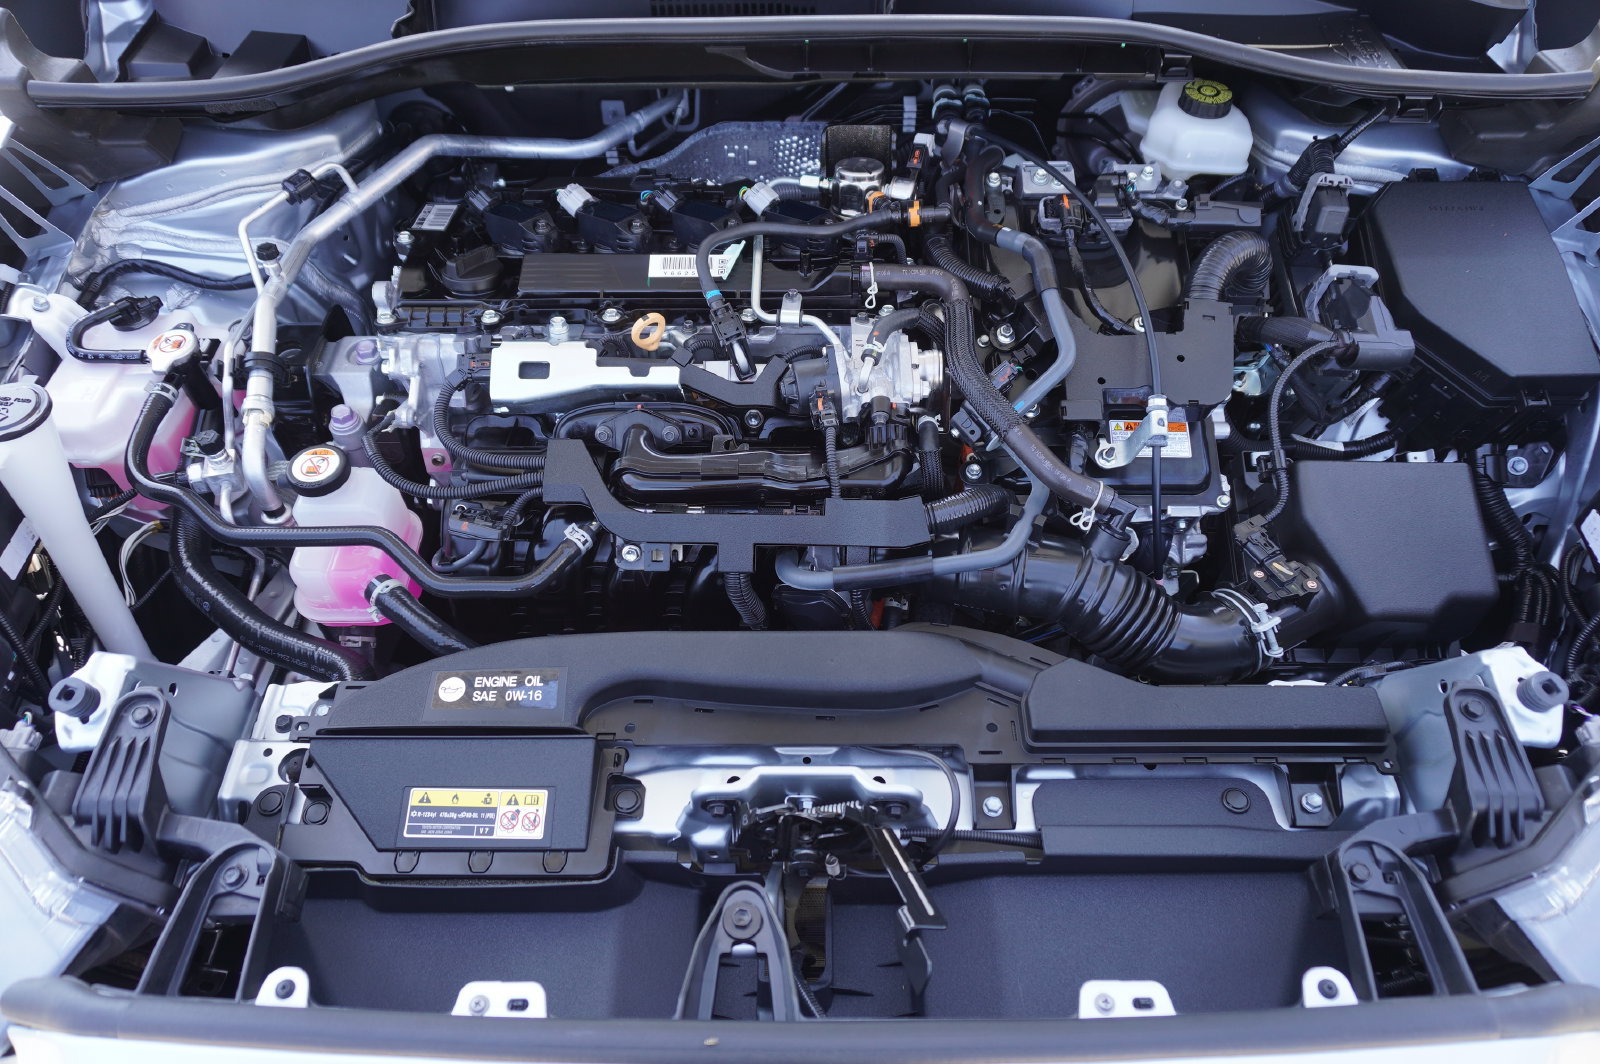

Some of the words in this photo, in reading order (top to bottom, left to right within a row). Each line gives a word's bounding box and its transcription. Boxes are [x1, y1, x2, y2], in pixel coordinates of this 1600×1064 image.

[474, 675, 518, 687] ENGINE
[524, 675, 544, 687] OIL
[472, 690, 498, 702] SAE
[505, 689, 543, 701] 0W-16
